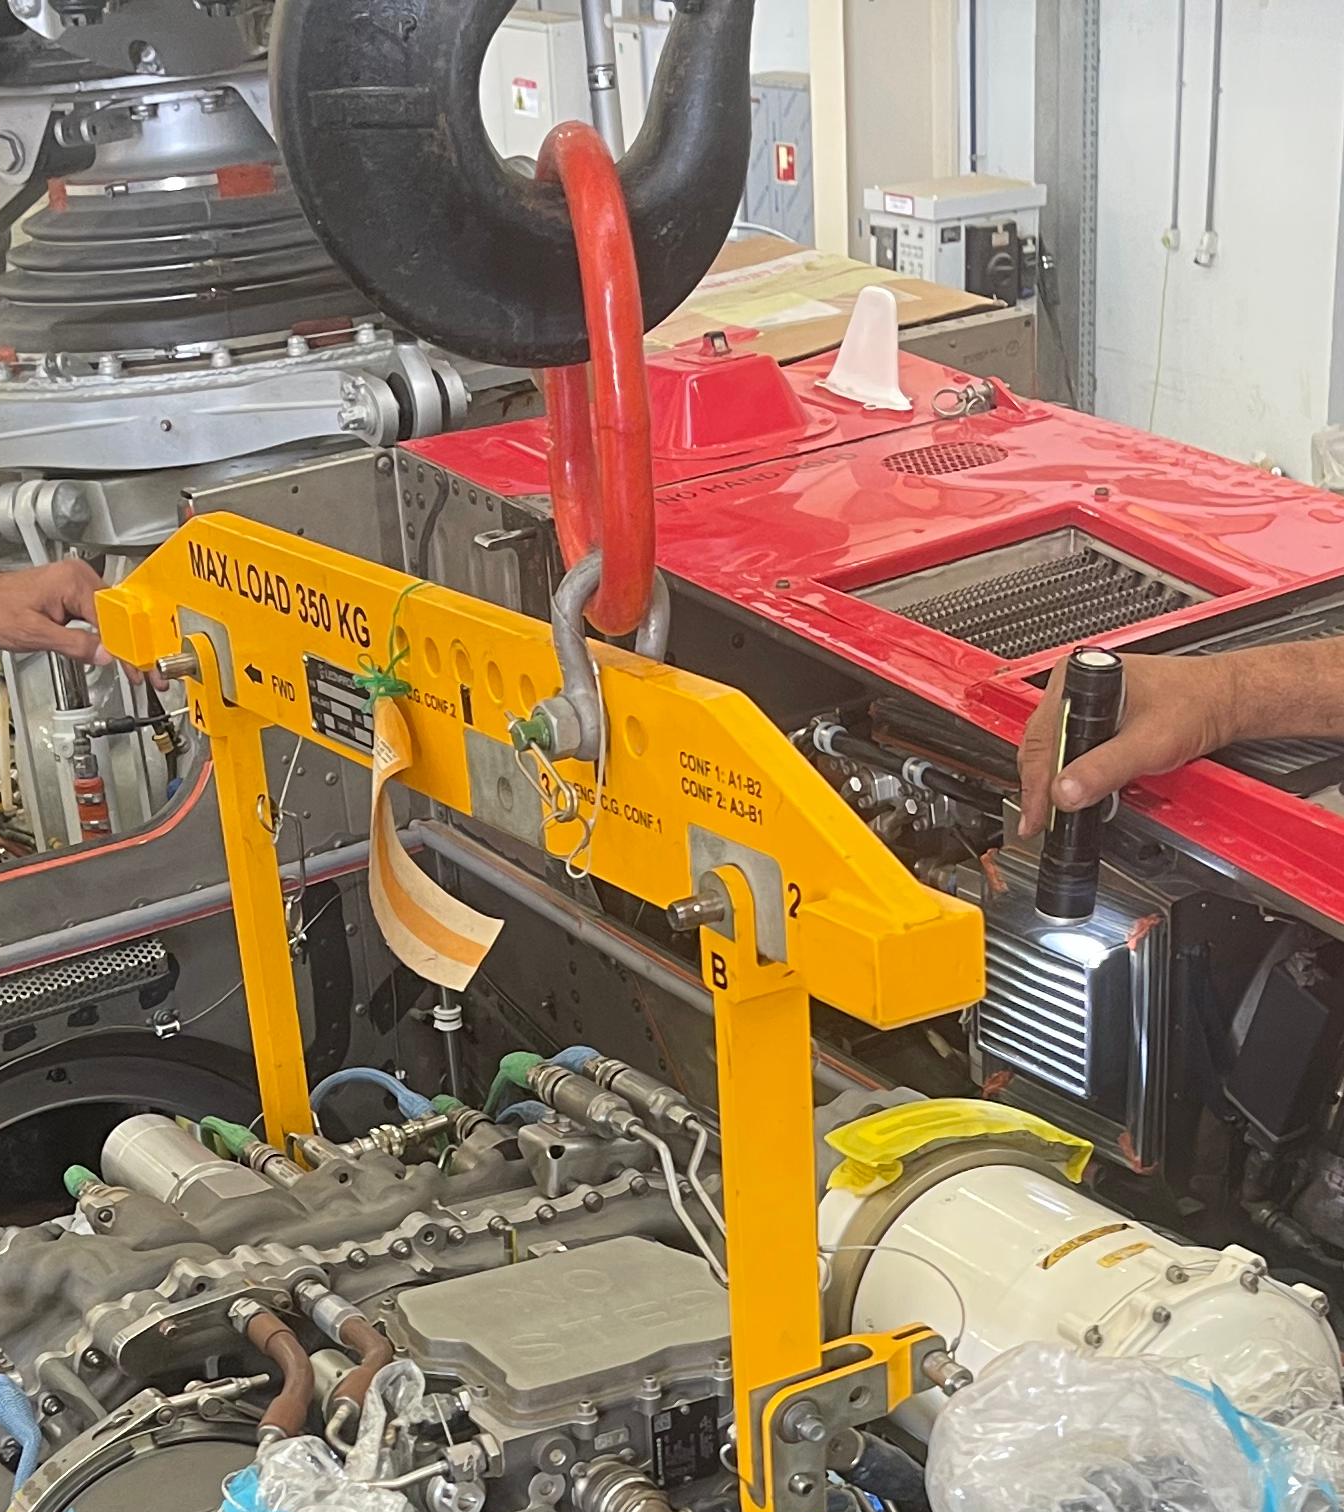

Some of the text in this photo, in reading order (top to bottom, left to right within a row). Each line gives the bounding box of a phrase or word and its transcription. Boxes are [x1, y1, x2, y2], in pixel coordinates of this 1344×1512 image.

[655, 490, 696, 506] NO
[702, 472, 781, 494] HAND
[188, 541, 371, 648] MAX LOAD 350 KG
[271, 675, 296, 702] FWD
[194, 699, 206, 728] A
[680, 751, 763, 799] CONF 1: A1-B2
[681, 776, 763, 826] CONF 2: A3-B1
[787, 883, 802, 919] 2
[711, 951, 728, 991] B
